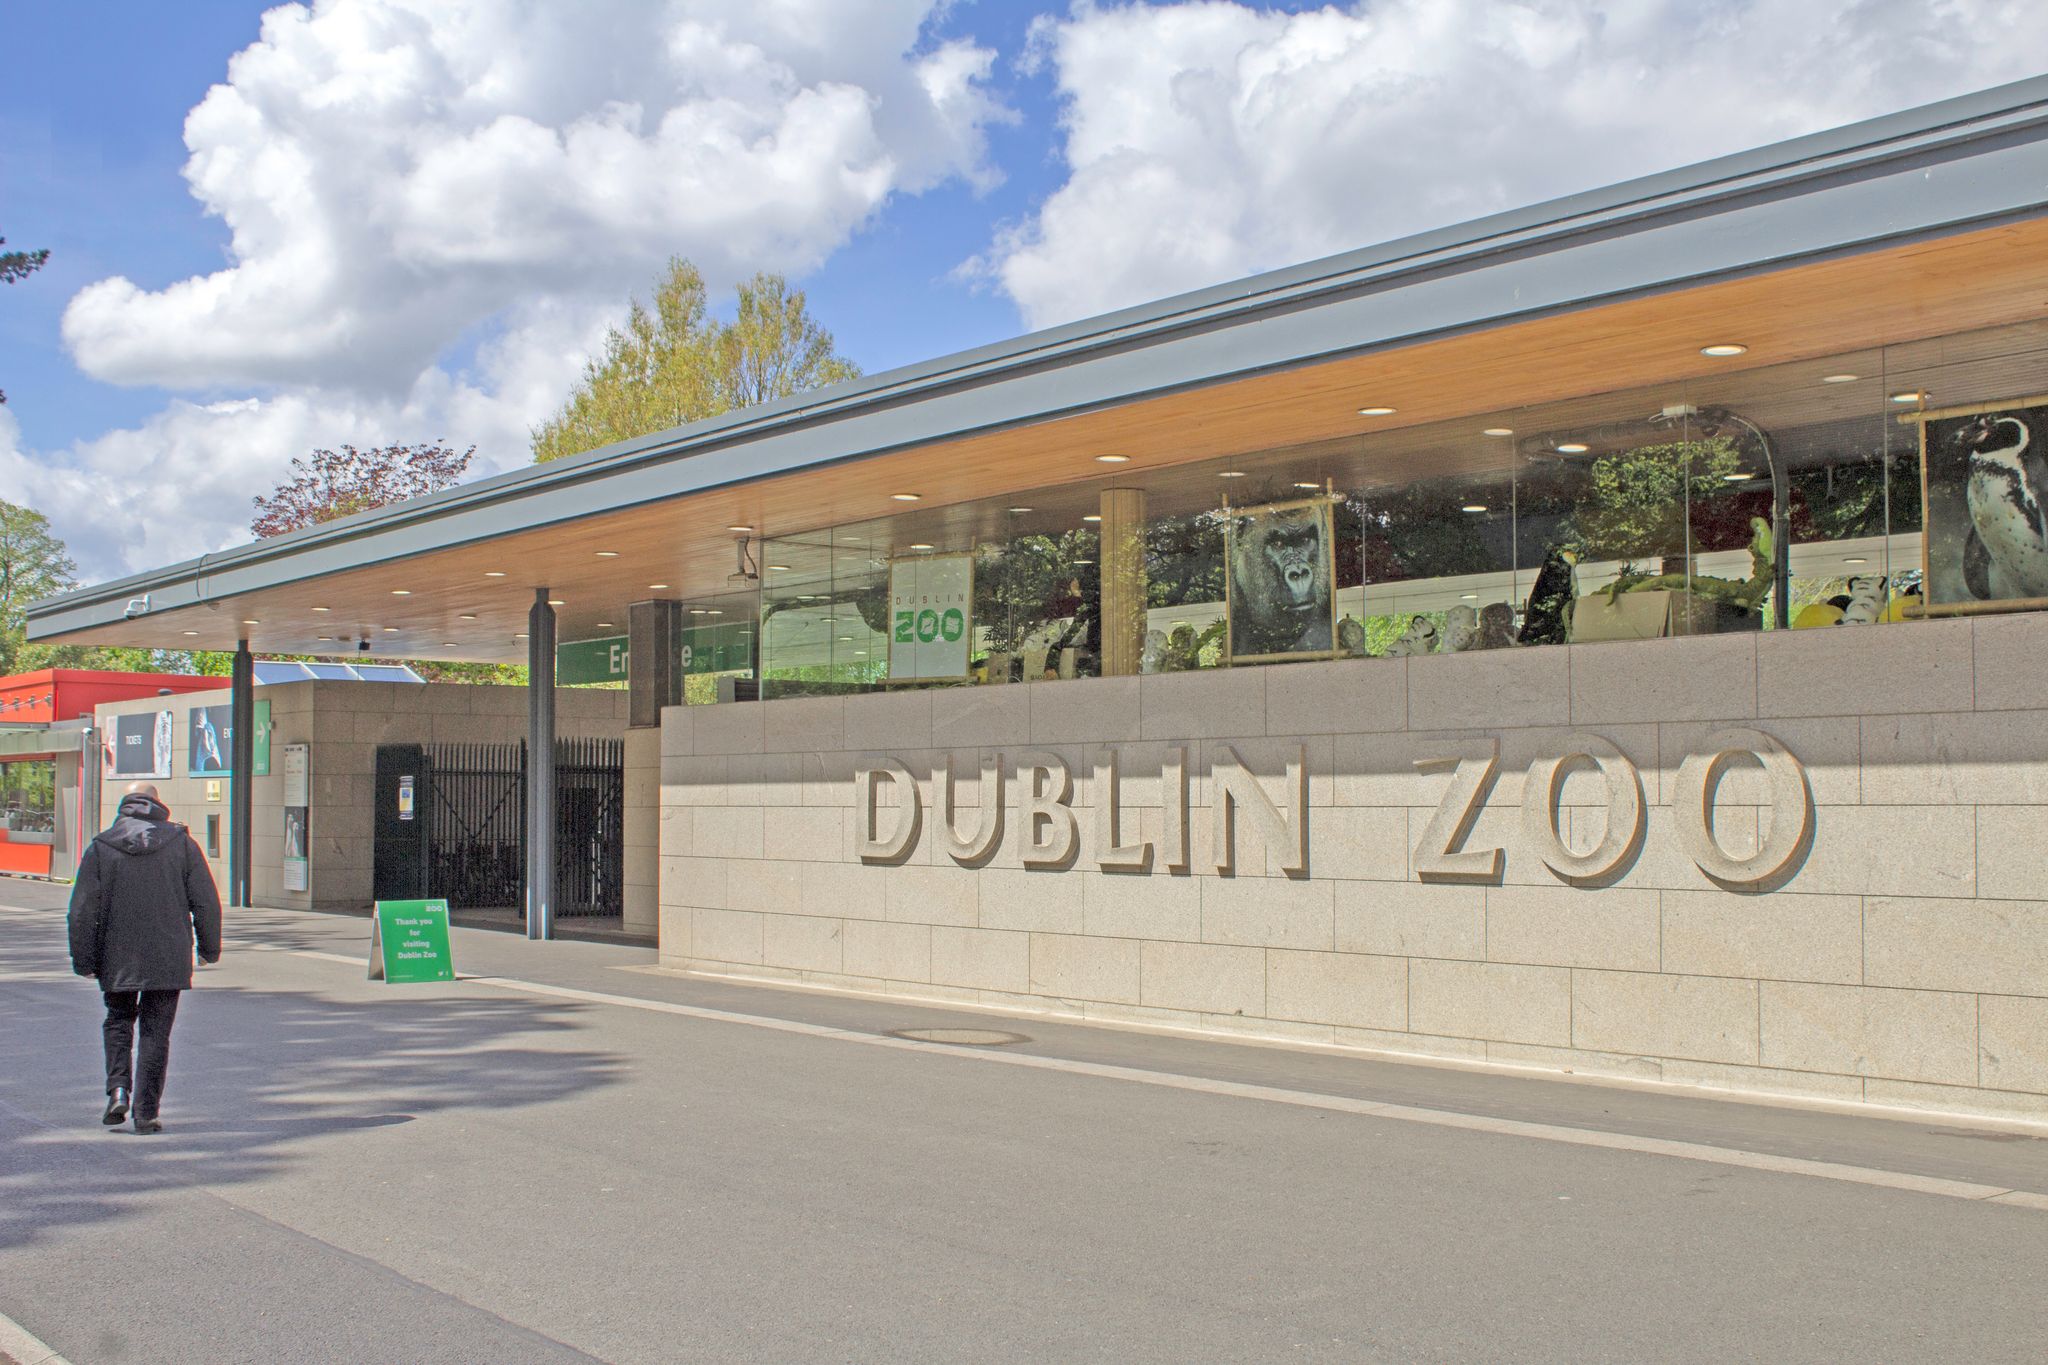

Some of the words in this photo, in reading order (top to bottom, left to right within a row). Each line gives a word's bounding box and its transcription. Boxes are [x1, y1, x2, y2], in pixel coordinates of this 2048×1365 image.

[896, 593, 964, 605] DUBLIN
[895, 607, 964, 643] ZOO
[855, 744, 1309, 879] DUBLIN
[1413, 728, 1816, 894] ZOO
[402, 940, 430, 948] visiting
[398, 951, 422, 959] Dublin
